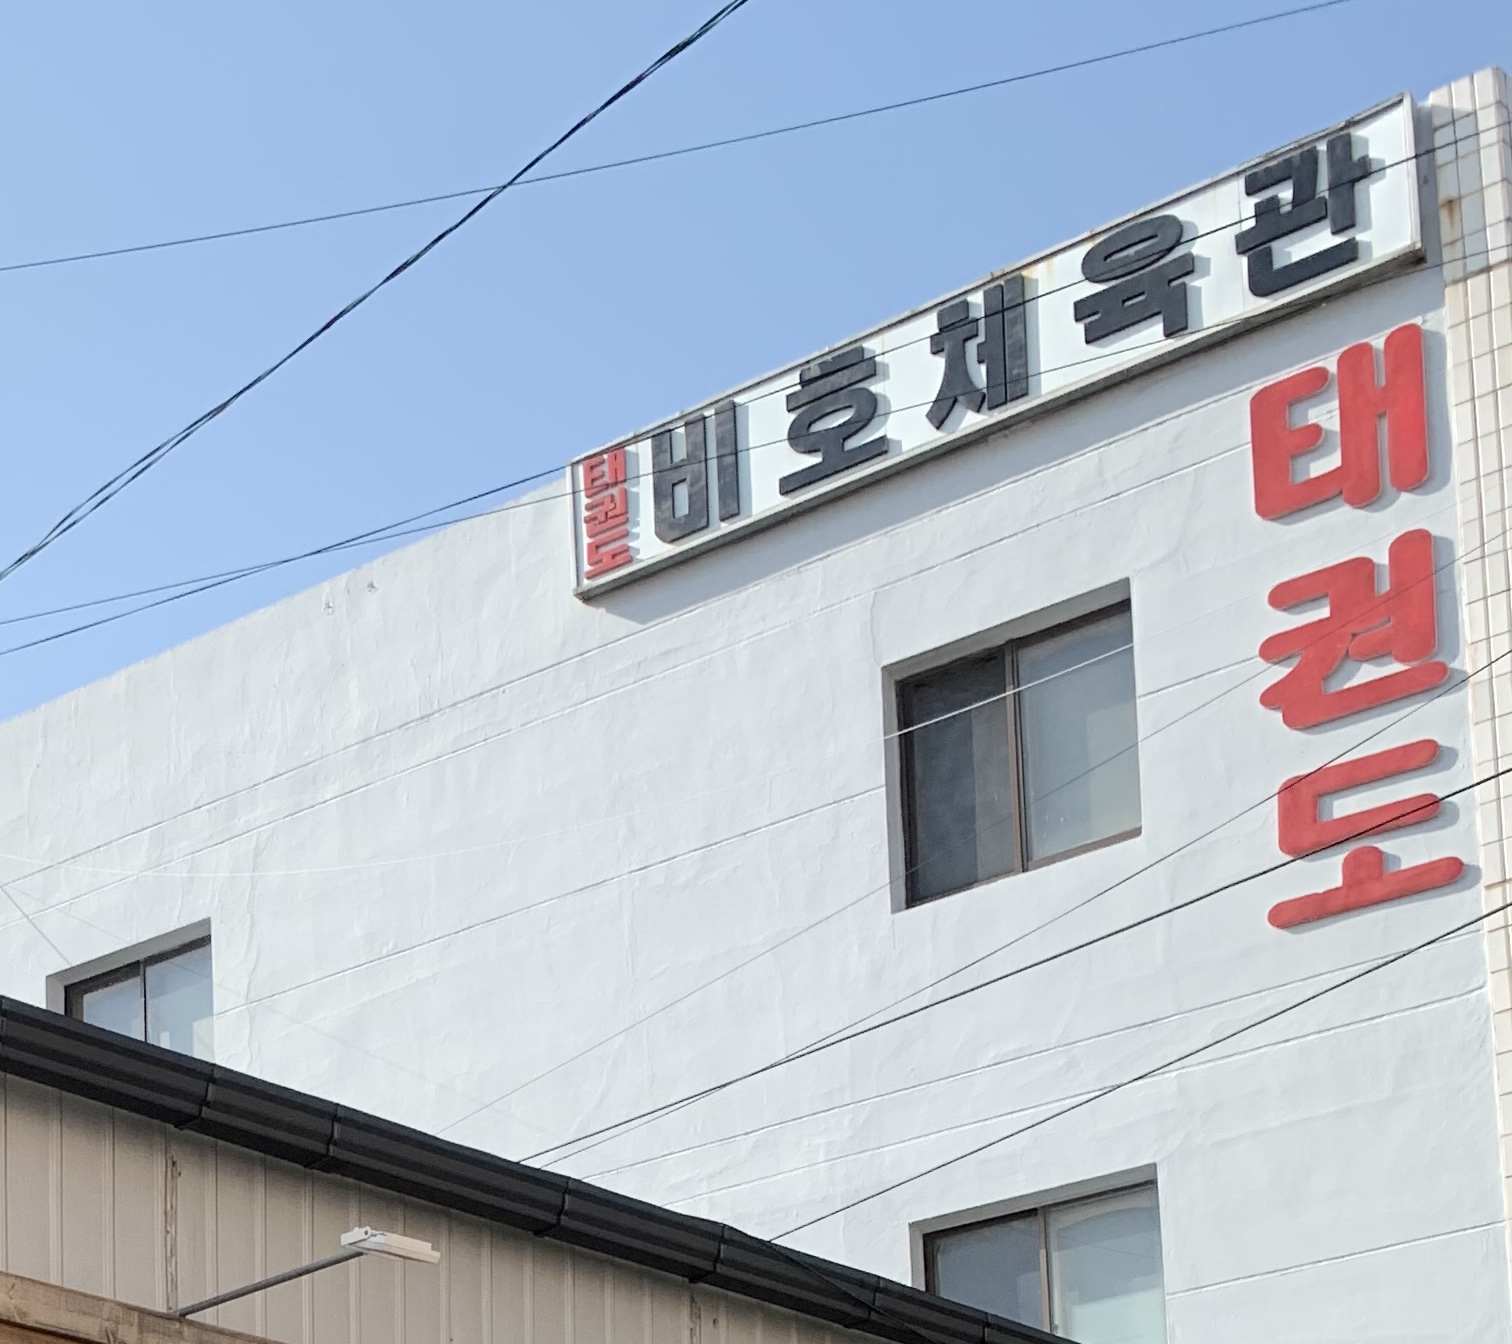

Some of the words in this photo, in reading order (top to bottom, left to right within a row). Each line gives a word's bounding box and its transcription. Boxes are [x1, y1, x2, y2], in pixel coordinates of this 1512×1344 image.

[582, 446, 633, 582] 태권도
[650, 132, 1374, 543] 비호체육관
[1249, 322, 1466, 930] 태권도
